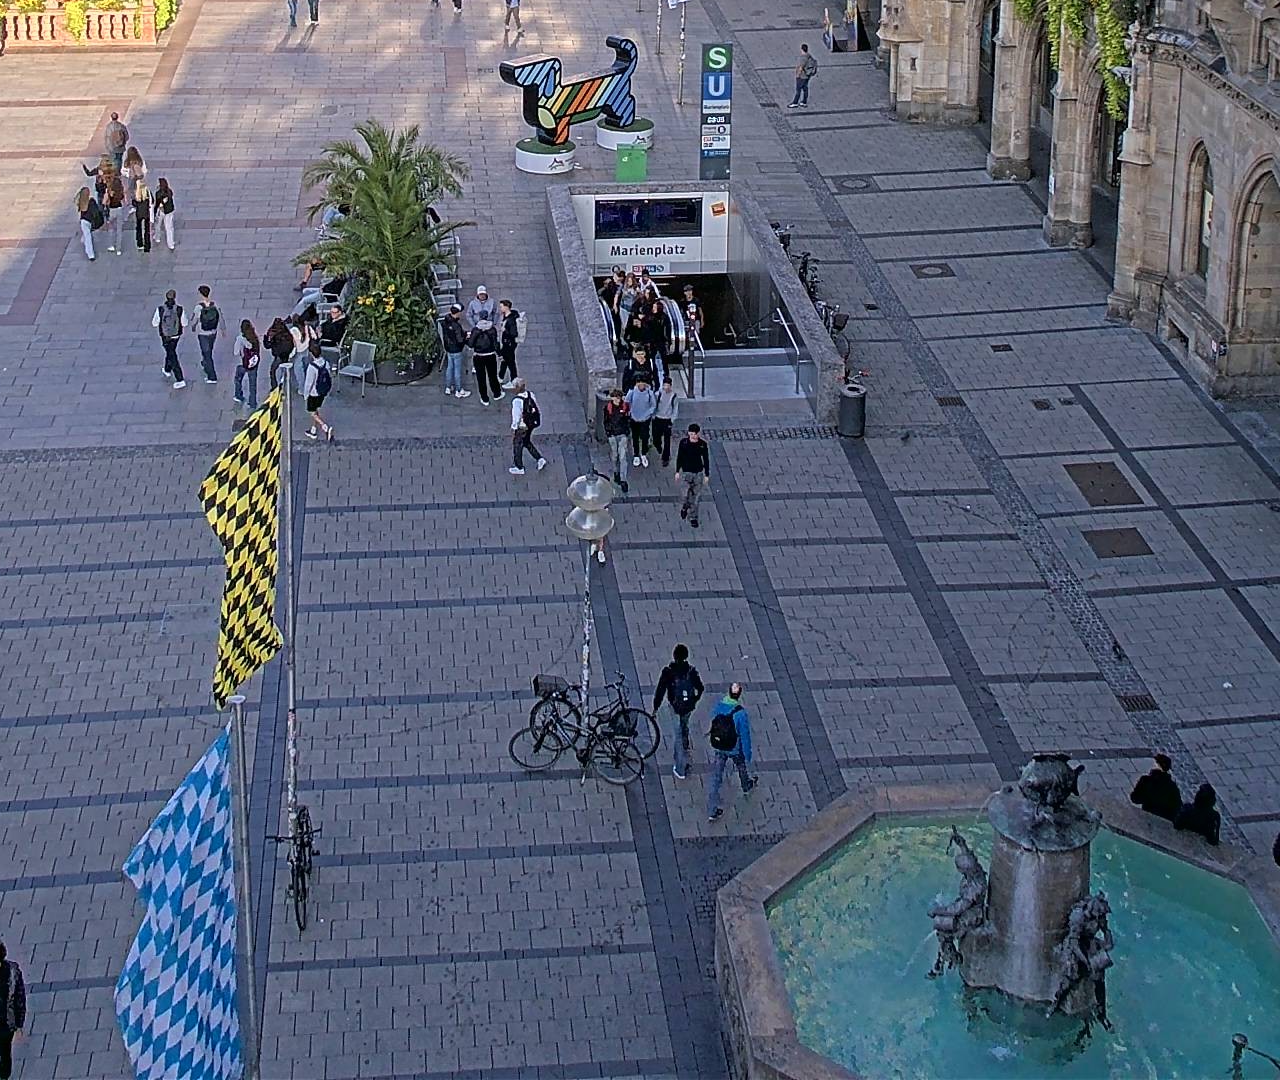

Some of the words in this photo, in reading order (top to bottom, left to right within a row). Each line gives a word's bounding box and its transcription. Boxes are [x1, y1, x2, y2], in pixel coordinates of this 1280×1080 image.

[709, 47, 727, 69] S
[708, 75, 725, 97] U
[610, 244, 686, 258] Marienplatz
